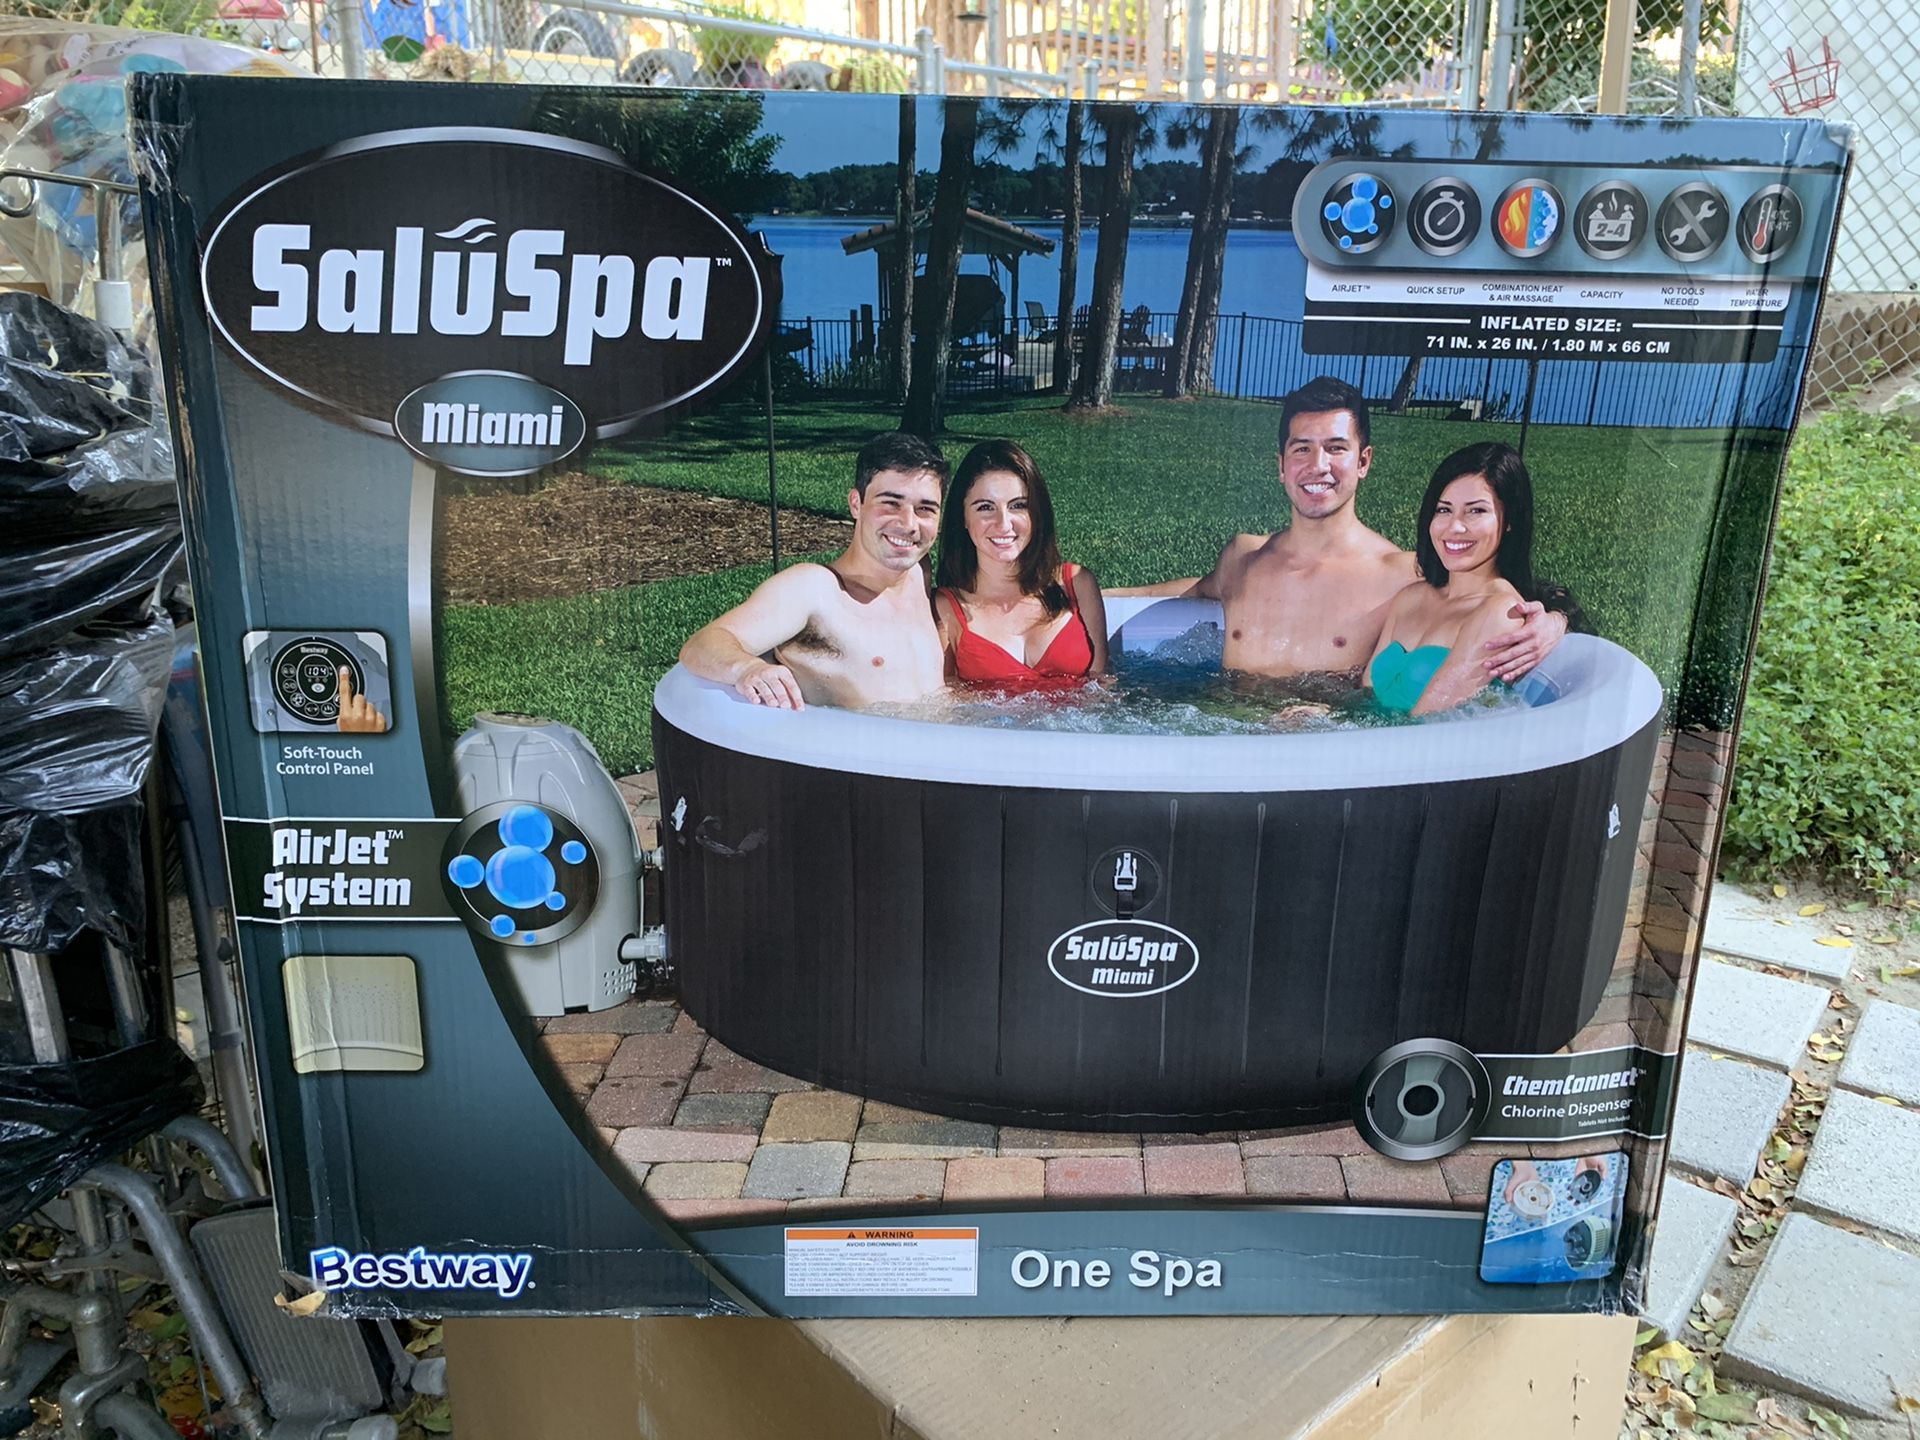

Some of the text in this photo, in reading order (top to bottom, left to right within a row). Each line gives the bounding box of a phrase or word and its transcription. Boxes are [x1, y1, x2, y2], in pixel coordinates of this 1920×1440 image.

[1594, 223, 1626, 238] 2-4
[1406, 286, 1465, 296] QUICK SETUP
[1481, 283, 1564, 293] COMBINATION HEAT
[1580, 290, 1624, 299] CAPACITY
[1661, 287, 1705, 296] NO TOOLS
[1488, 294, 1554, 303] & AIR MASSAGE
[1664, 297, 1699, 306] NEEDED
[1480, 315, 1622, 333] INFLATED SIZE:
[1426, 335, 1670, 354] 71 IN. x 26 IN. / 1.80 M x 66 CM
[422, 402, 564, 446] Miami
[308, 667, 327, 676] 104
[283, 746, 362, 760] Soft-Touch
[276, 762, 374, 775] Control Panel
[263, 871, 411, 915] System
[1091, 968, 1154, 984] Miami
[1501, 1098, 1633, 1118] Chlorine Dispenser
[865, 1231, 914, 1239] WARNING
[1011, 1250, 1222, 1297] One Spa
